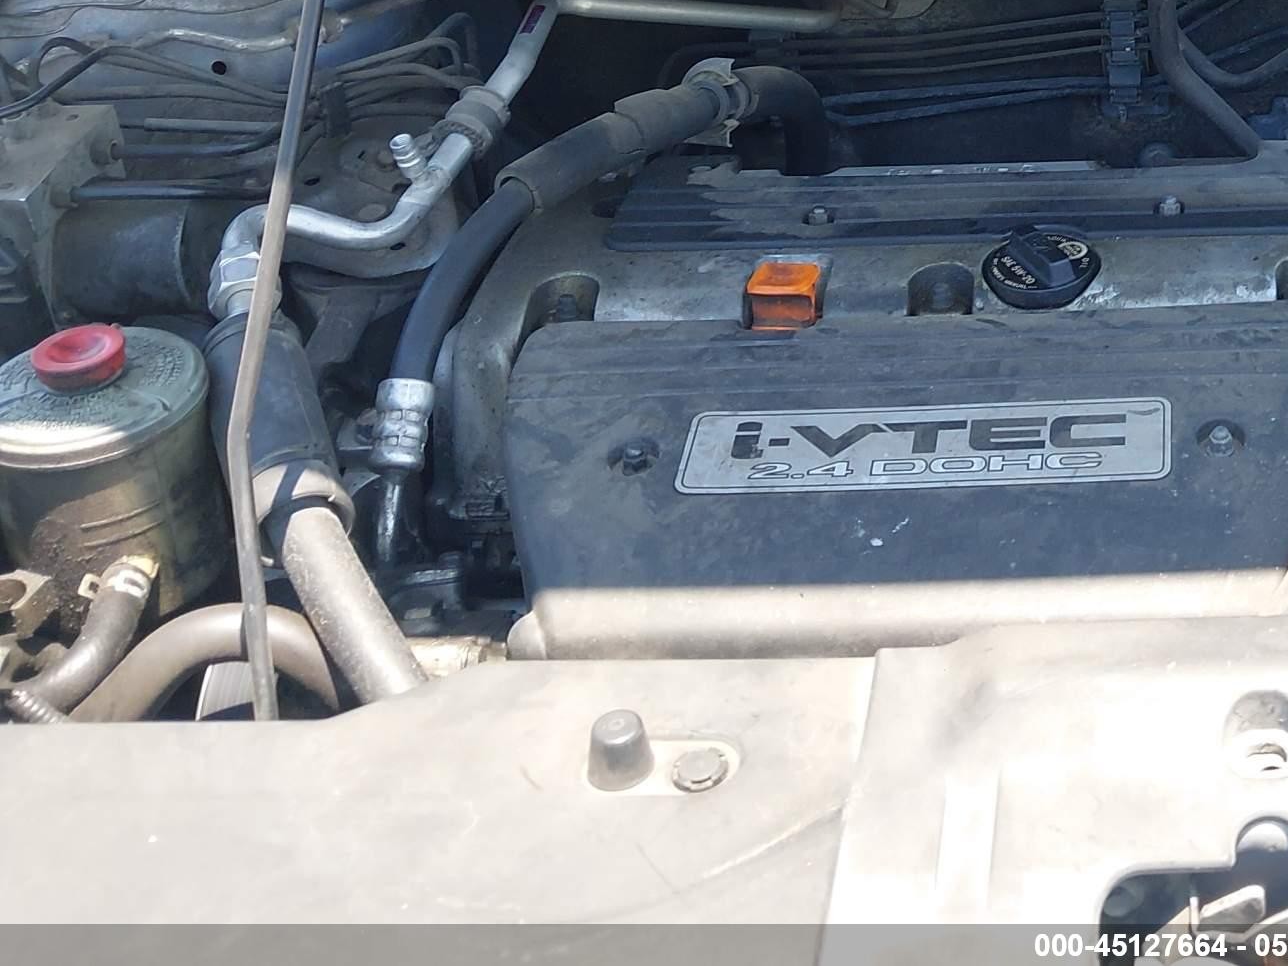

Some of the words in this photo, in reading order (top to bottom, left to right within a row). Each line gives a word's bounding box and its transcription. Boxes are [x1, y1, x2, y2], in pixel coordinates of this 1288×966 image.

[730, 414, 1127, 460] i-VTEC
[747, 459, 855, 480] 2.4
[869, 451, 1104, 477] DOHC
